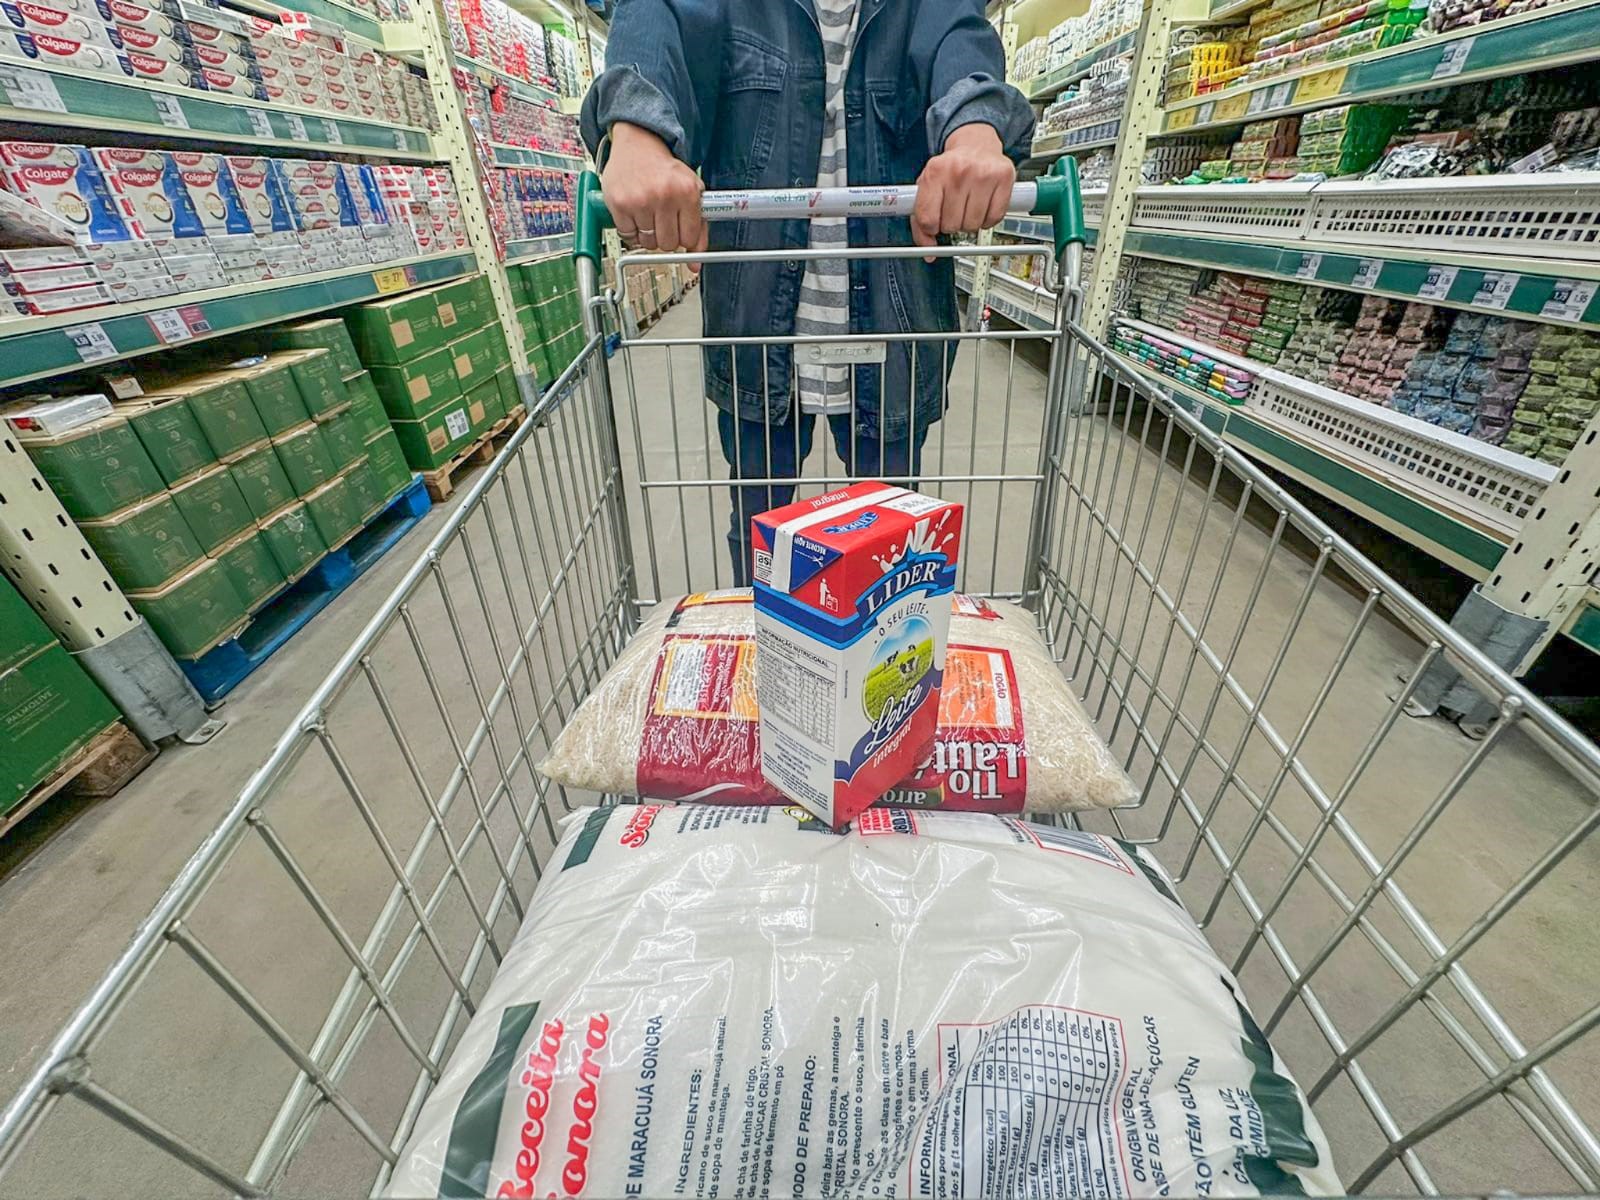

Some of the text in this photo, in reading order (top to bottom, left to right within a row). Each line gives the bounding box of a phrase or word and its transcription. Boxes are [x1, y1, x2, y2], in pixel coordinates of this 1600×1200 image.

[20, 4, 64, 22] Colgate
[34, 36, 77, 52] Colgate
[120, 28, 155, 45] Colgate
[130, 54, 164, 71] Colgate
[25, 168, 69, 180] Colgate
[121, 171, 157, 182] Colgate
[811, 491, 849, 510] integral
[866, 561, 937, 615] LIDER
[880, 602, 926, 637] O SEU LEITE
[864, 684, 924, 755] Leite
[878, 789, 927, 806] arro
[949, 769, 1003, 800] Tio
[762, 1006, 774, 1051] SONORA.
[855, 1017, 866, 1054] farinha
[880, 1018, 890, 1040] bata
[1020, 1017, 1029, 1030] 0%
[1033, 1017, 1041, 1030] 0%
[1045, 1019, 1053, 1032] 0%
[1057, 1020, 1066, 1034] 0%
[1070, 1023, 1079, 1037] 0%
[1108, 1022, 1121, 1049] porção
[832, 1025, 845, 1074] manteiga
[906, 1029, 917, 1063] forma
[1112, 1050, 1121, 1068] pela
[712, 1052, 724, 1097] maracujá
[881, 1051, 890, 1075] neve
[909, 1062, 918, 1089] uma
[985, 1064, 994, 1081] 400
[1010, 1066, 1019, 1083] 100
[747, 1066, 758, 1093] trigo.
[759, 1054, 770, 1099] CRISTAL
[832, 1076, 839, 1085] a
[856, 1063, 866, 1094] suco,
[1076, 1127, 1086, 1142] (g)
[1082, 1025, 1091, 1040] 0%
[1141, 1015, 1164, 1156] DE CANA-DE-AÇÚCAR
[1174, 1055, 1201, 1110] GLÚTEN
[547, 1013, 609, 1200] onora
[628, 1015, 663, 1180] MARACUJÁ SONORA
[709, 1100, 716, 1112] de
[717, 1083, 730, 1134] manteiga.
[747, 1095, 755, 1108] de
[796, 1054, 817, 1160] DE PREPARO:
[828, 1085, 840, 1128] gemas,
[855, 1096, 863, 1104] o
[880, 1091, 891, 1128] claras
[895, 1094, 902, 1102] e
[908, 1089, 917, 1104] em
[1093, 1028, 1104, 1190] (mg) 0%
[1122, 1066, 1143, 1127] VEGETAL
[1217, 1087, 1239, 1110] LUZ,
[754, 1100, 767, 1146] AÇÚCAR
[837, 1091, 850, 1148] SONORA.
[954, 1105, 962, 1117] de
[986, 1108, 995, 1137] (kcal)
[998, 1065, 1009, 1157] Totais (g) 100
[674, 1068, 702, 1193] INGREDIENTES:
[705, 1115, 715, 1141] suco
[742, 1112, 754, 1150] farinha
[761, 1065, 785, 1187] sopa de fermento em pó
[826, 1130, 835, 1146] as
[854, 1107, 864, 1167] acrescente
[950, 1119, 961, 1149] colher
[1012, 1127, 1021, 1144] (g)
[1228, 1115, 1244, 1140] DA
[702, 1143, 710, 1158] de
[713, 1137, 723, 1150] de
[1020, 1110, 1034, 1171] Adicionados
[1055, 1126, 1065, 1175] Saturadas
[1064, 1134, 1074, 1149] (g)
[711, 1153, 723, 1183] sopa
[741, 1150, 749, 1163] de
[753, 1148, 761, 1162] de
[822, 1148, 833, 1170] bata
[864, 1148, 876, 1168] pó.
[939, 1154, 947, 1173] por
[985, 1140, 996, 1195] energético
[1041, 1147, 1050, 1174] Totais
[1067, 1148, 1076, 1174] Trans
[738, 1165, 747, 1186] chá
[1029, 1162, 1039, 1177] (g)
